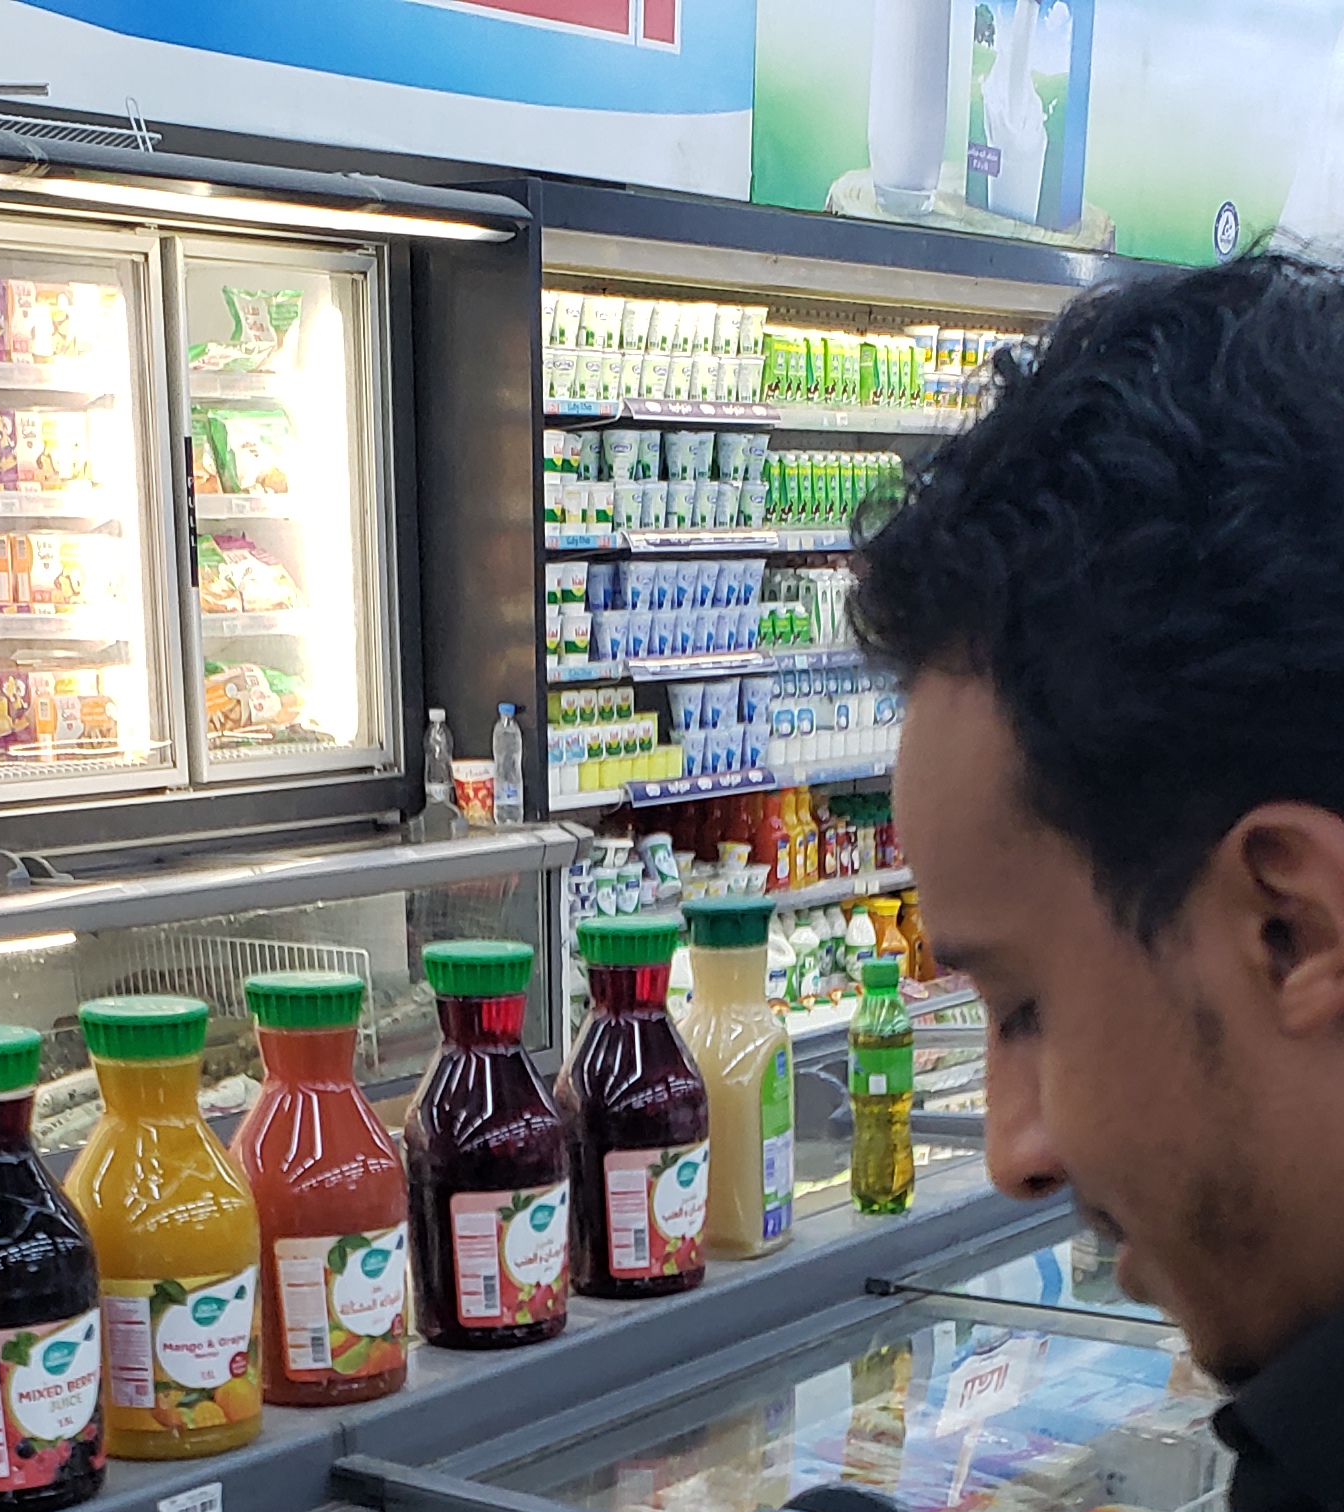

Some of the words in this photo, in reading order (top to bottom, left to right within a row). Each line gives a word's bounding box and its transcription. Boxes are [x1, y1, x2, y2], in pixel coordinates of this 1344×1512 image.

[163, 1342, 204, 1353] Mango
[18, 1382, 63, 1404] MIXED
[49, 1393, 82, 1413] JUICE
